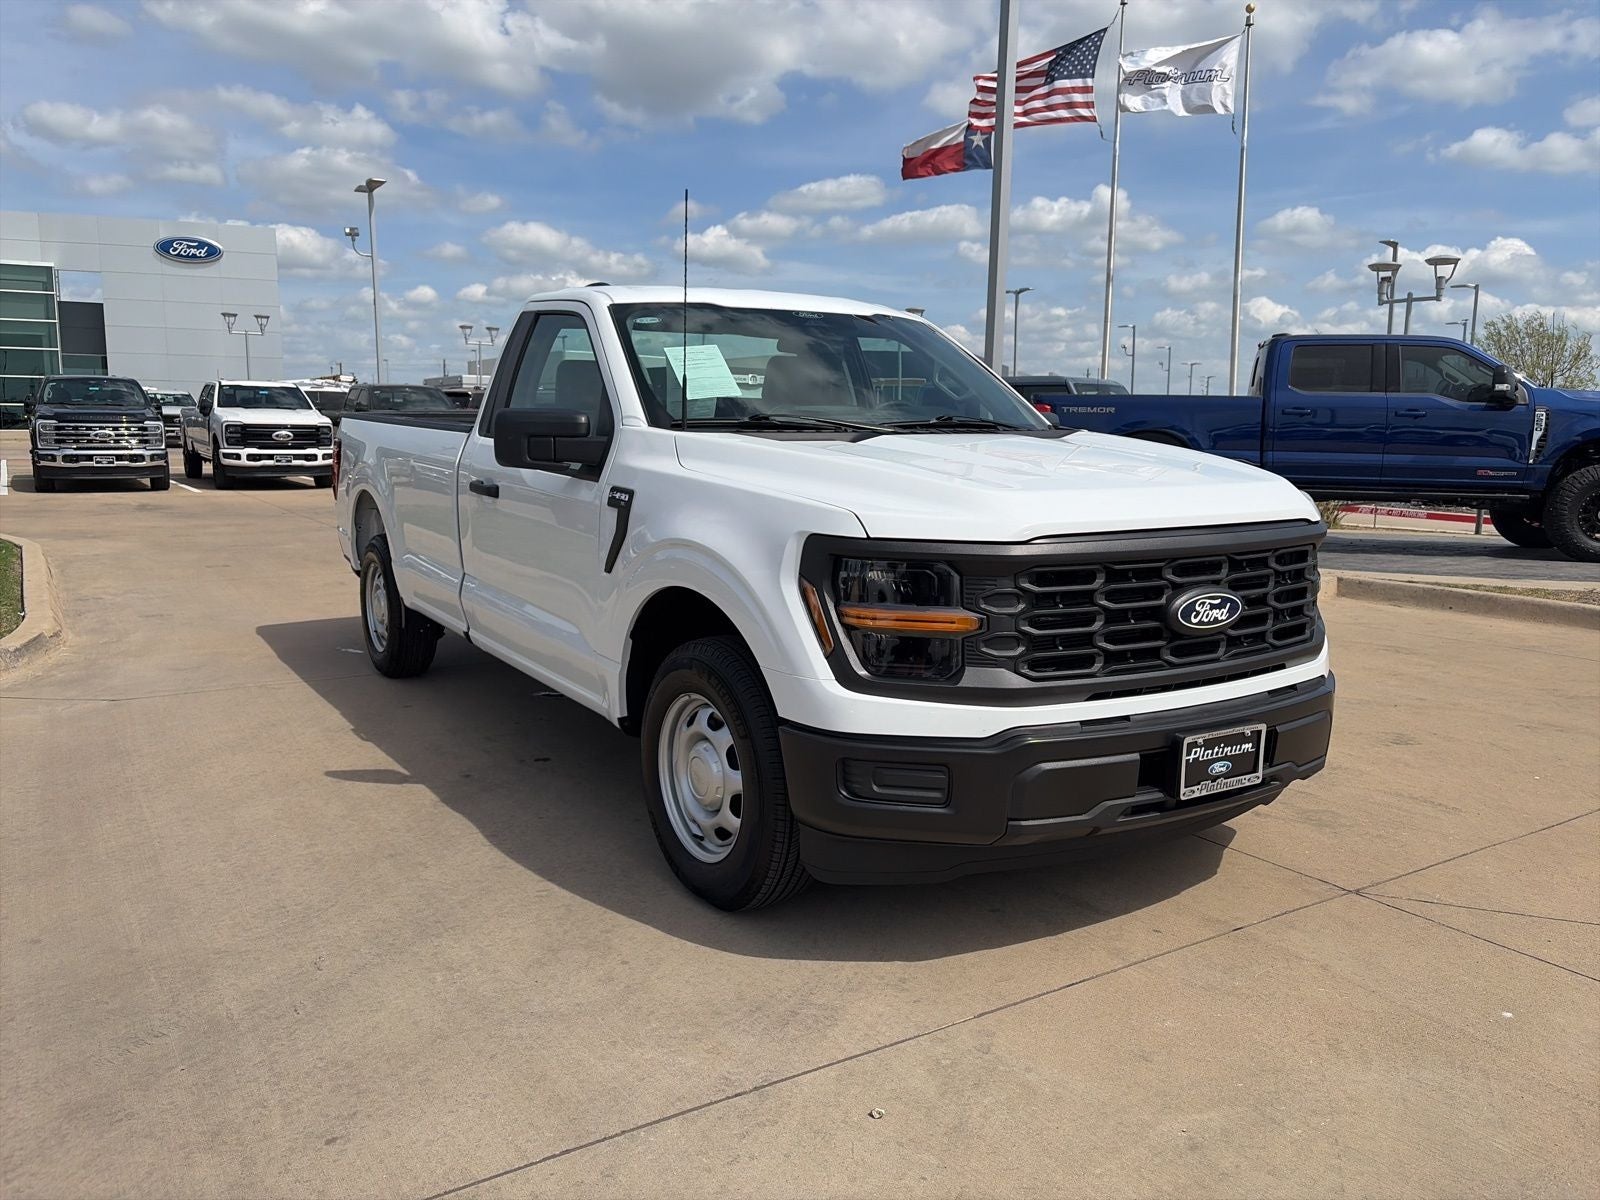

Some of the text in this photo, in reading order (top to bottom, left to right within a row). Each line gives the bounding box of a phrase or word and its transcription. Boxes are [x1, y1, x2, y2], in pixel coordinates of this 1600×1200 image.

[1124, 67, 1230, 86] Platinum
[169, 240, 208, 257] Ford
[1402, 510, 1428, 519] PARKING
[1191, 598, 1230, 623] Ford
[1185, 742, 1256, 763] Platinum
[1200, 778, 1246, 794] Platinum
